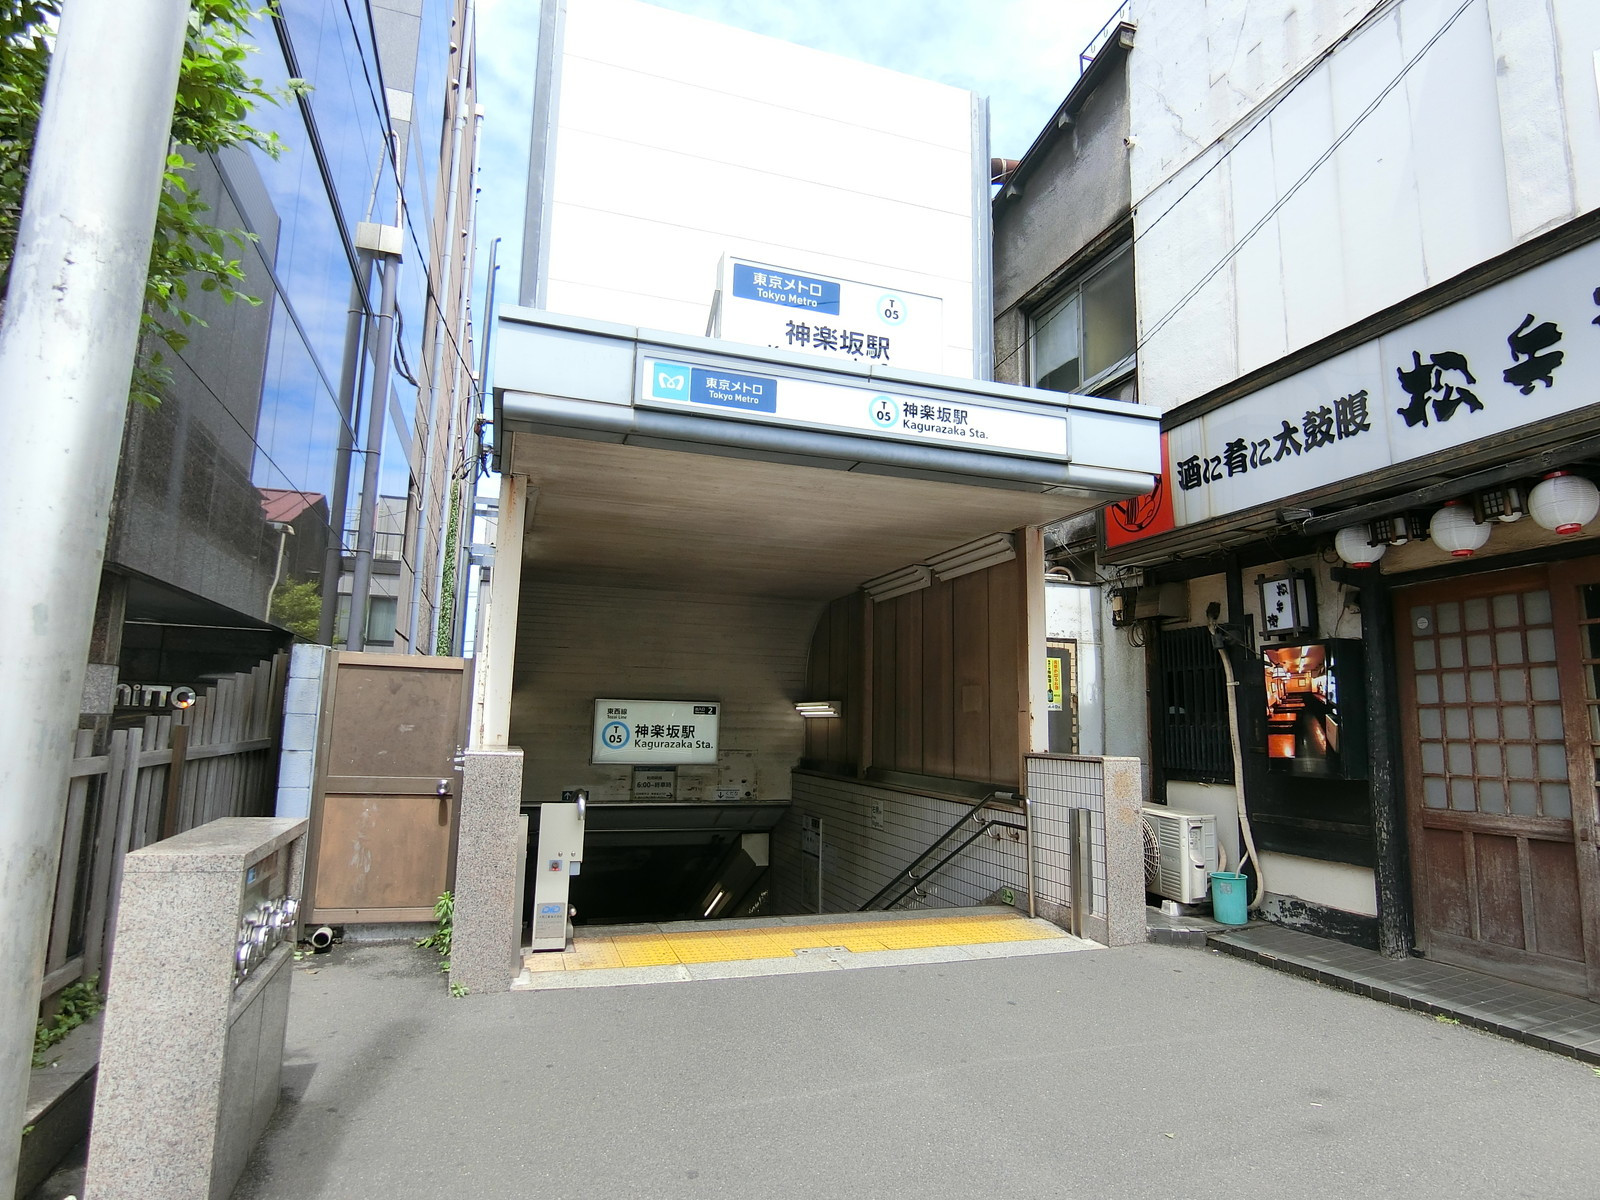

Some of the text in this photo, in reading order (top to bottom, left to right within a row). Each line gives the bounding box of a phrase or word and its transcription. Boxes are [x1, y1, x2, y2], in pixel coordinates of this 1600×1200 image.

[753, 272, 822, 297] 東京メトロ
[757, 287, 818, 308] Tokyo Metro
[889, 299, 895, 308] T
[884, 308, 899, 320] 05
[785, 319, 890, 361] 神楽坂駅
[1397, 286, 1600, 428] 松兵
[706, 377, 763, 395] 東京メトロ
[709, 390, 759, 404] Tokyo Metro
[881, 401, 887, 410] T
[876, 410, 891, 422] 05
[902, 401, 968, 425] 神楽坂駅
[903, 419, 989, 439] Kagurazaka Sta.
[1176, 389, 1371, 491] 酒に肴に太鼓腹
[607, 707, 628, 715] 東西線
[707, 706, 713, 715] 2
[613, 726, 619, 734] T
[634, 723, 696, 739] 神楽坂駅
[608, 734, 623, 743] 05
[634, 739, 714, 751] Kagurazaka Sta.
